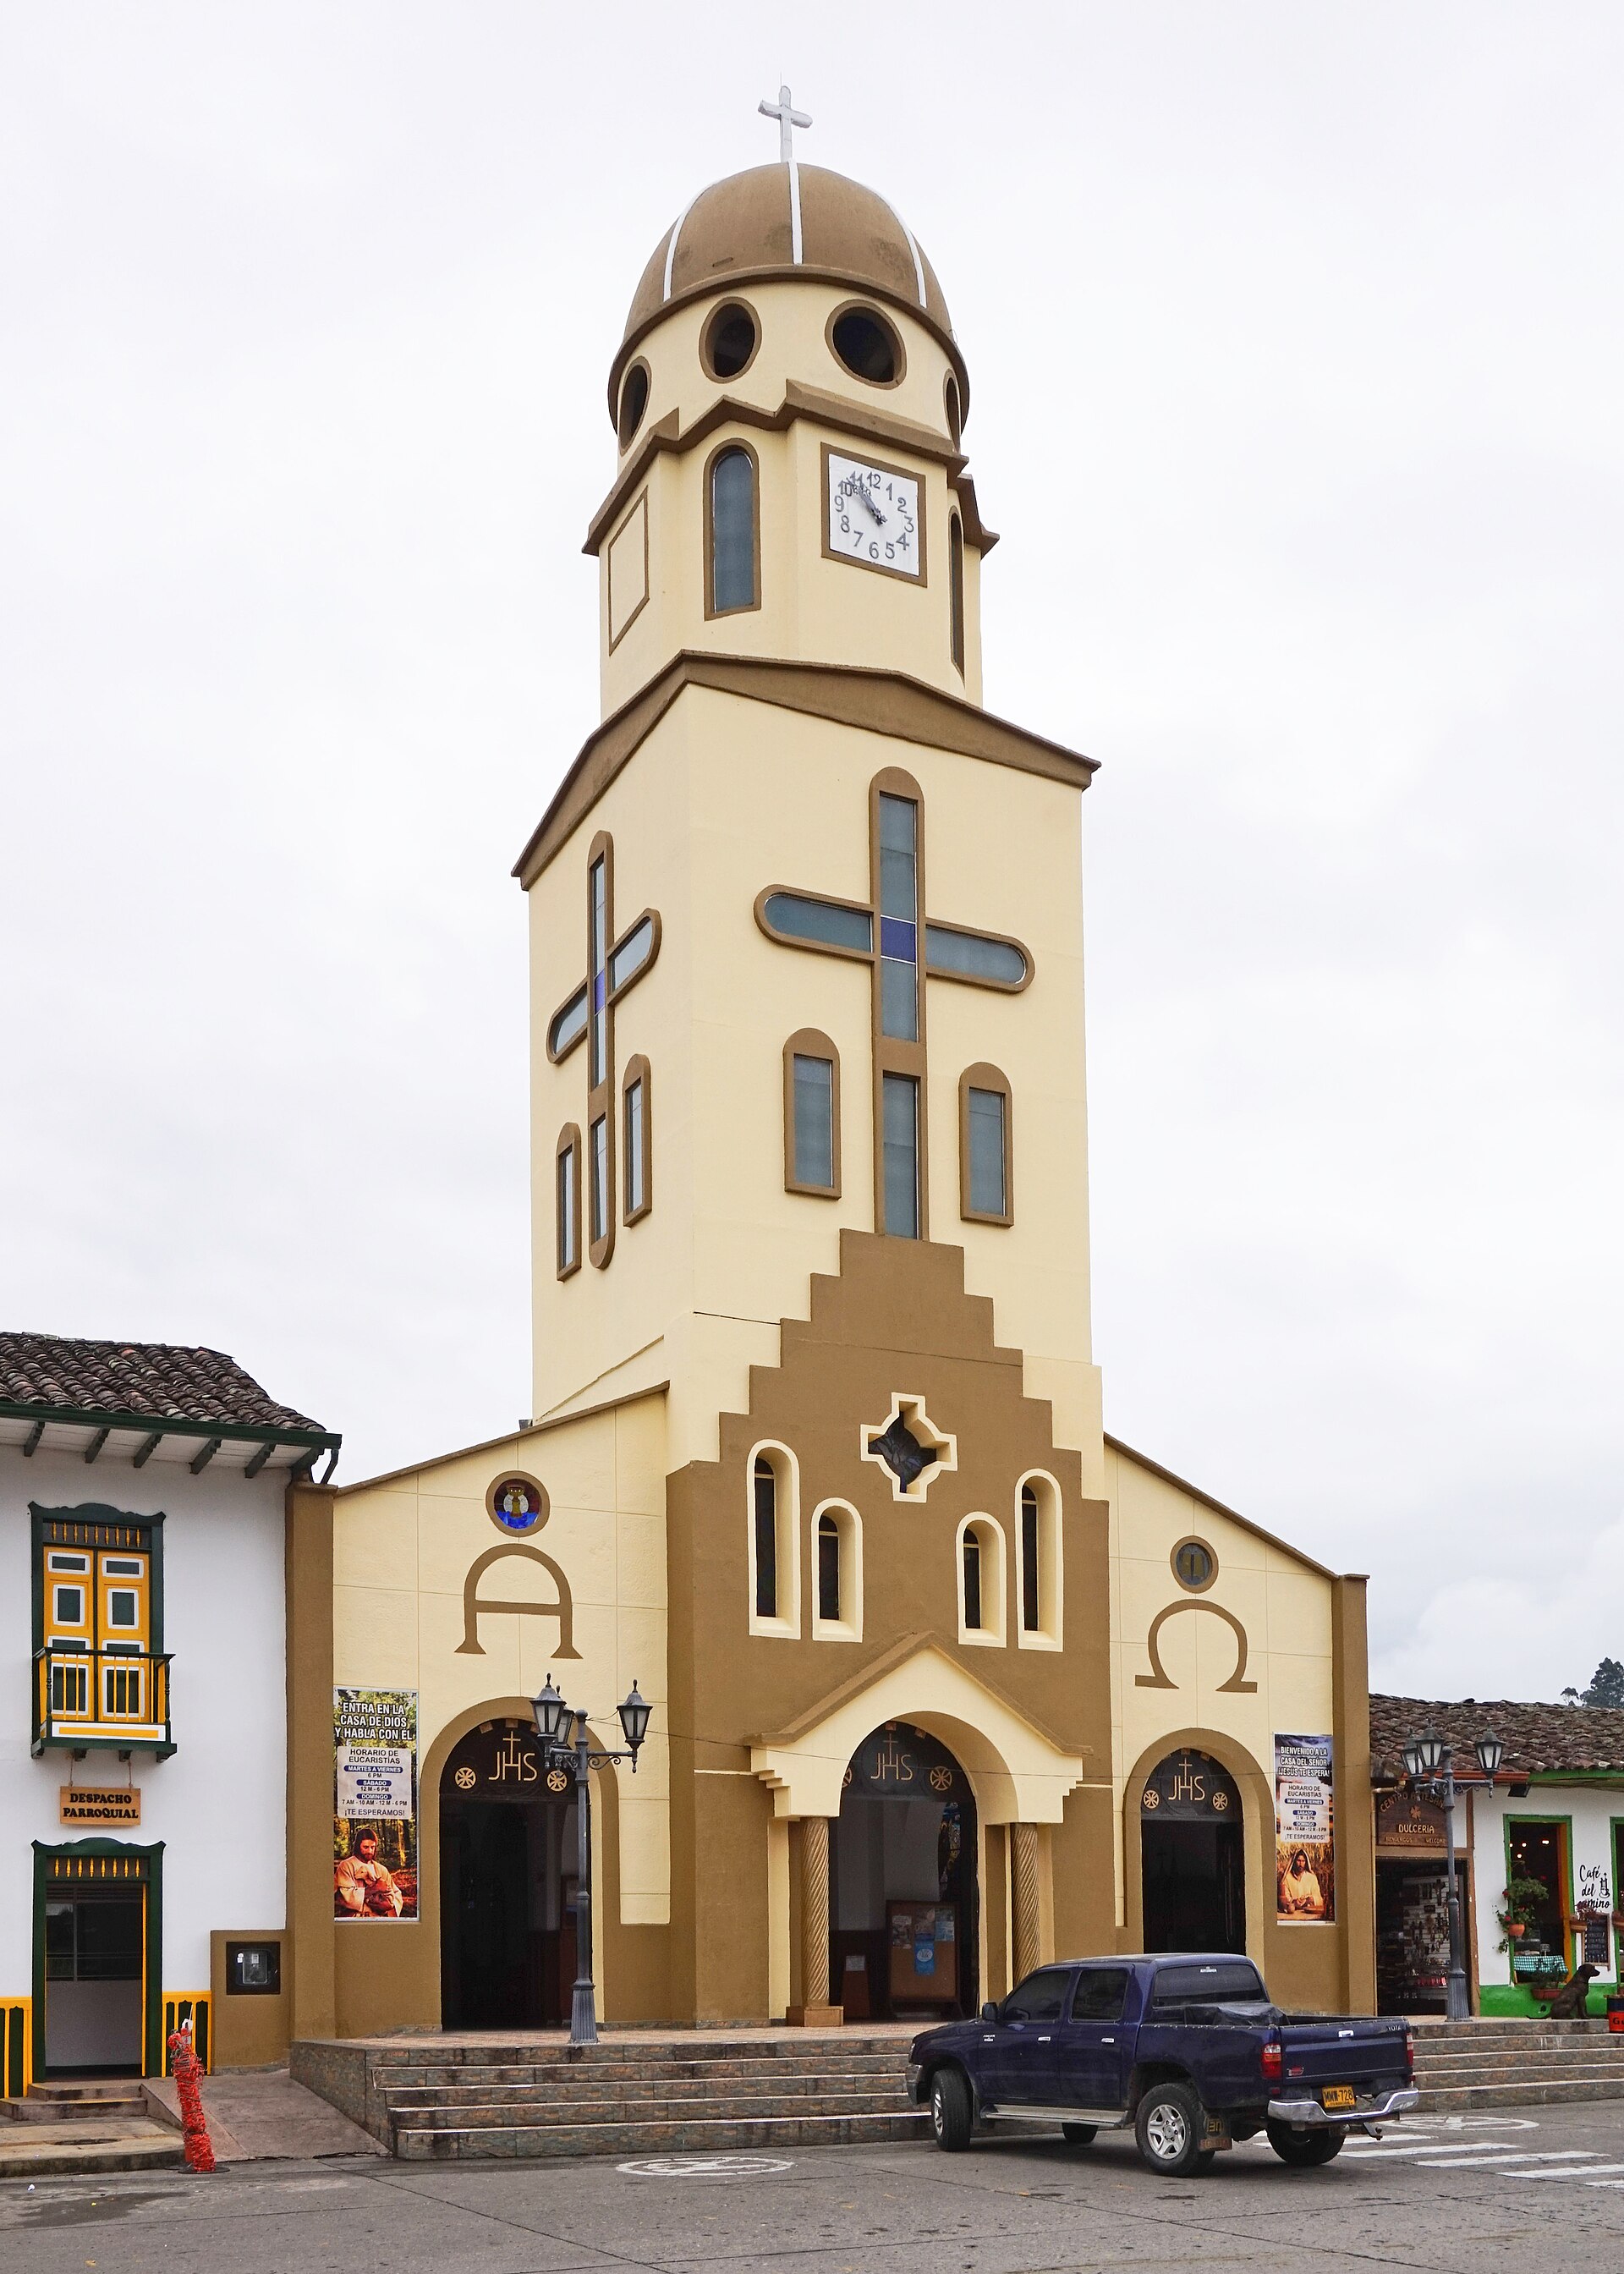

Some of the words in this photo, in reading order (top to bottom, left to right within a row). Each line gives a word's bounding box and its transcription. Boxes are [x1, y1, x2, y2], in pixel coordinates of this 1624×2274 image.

[867, 471, 881, 489] 12
[886, 482, 892, 501] 1
[834, 495, 844, 512] 9
[897, 497, 907, 514] 2
[840, 515, 850, 533] 8
[904, 516, 914, 532] 3
[853, 530, 864, 547] 7
[896, 532, 909, 551] 4
[870, 541, 879, 559] 6
[885, 541, 895, 559] 5
[343, 1703, 374, 1713] ENTRA
[377, 1705, 390, 1714] EN
[392, 1705, 404, 1715] LA
[340, 1715, 366, 1726] CASA
[370, 1716, 381, 1727] DE
[384, 1716, 407, 1727] DIOS
[335, 1727, 341, 1737] Y
[344, 1728, 376, 1738] HABLA
[379, 1729, 398, 1740] CON
[401, 1727, 413, 1740] ÉL
[1281, 1746, 1314, 1755] BIENVENIDO
[1320, 1748, 1327, 1756] LA
[1309, 1757, 1327, 1766] SEÑOR
[70, 1793, 132, 1804] DESPACHO
[63, 1807, 139, 1819] PARROQUIAL
[1579, 1865, 1600, 1882] Café
[1582, 1883, 1596, 1897] del
